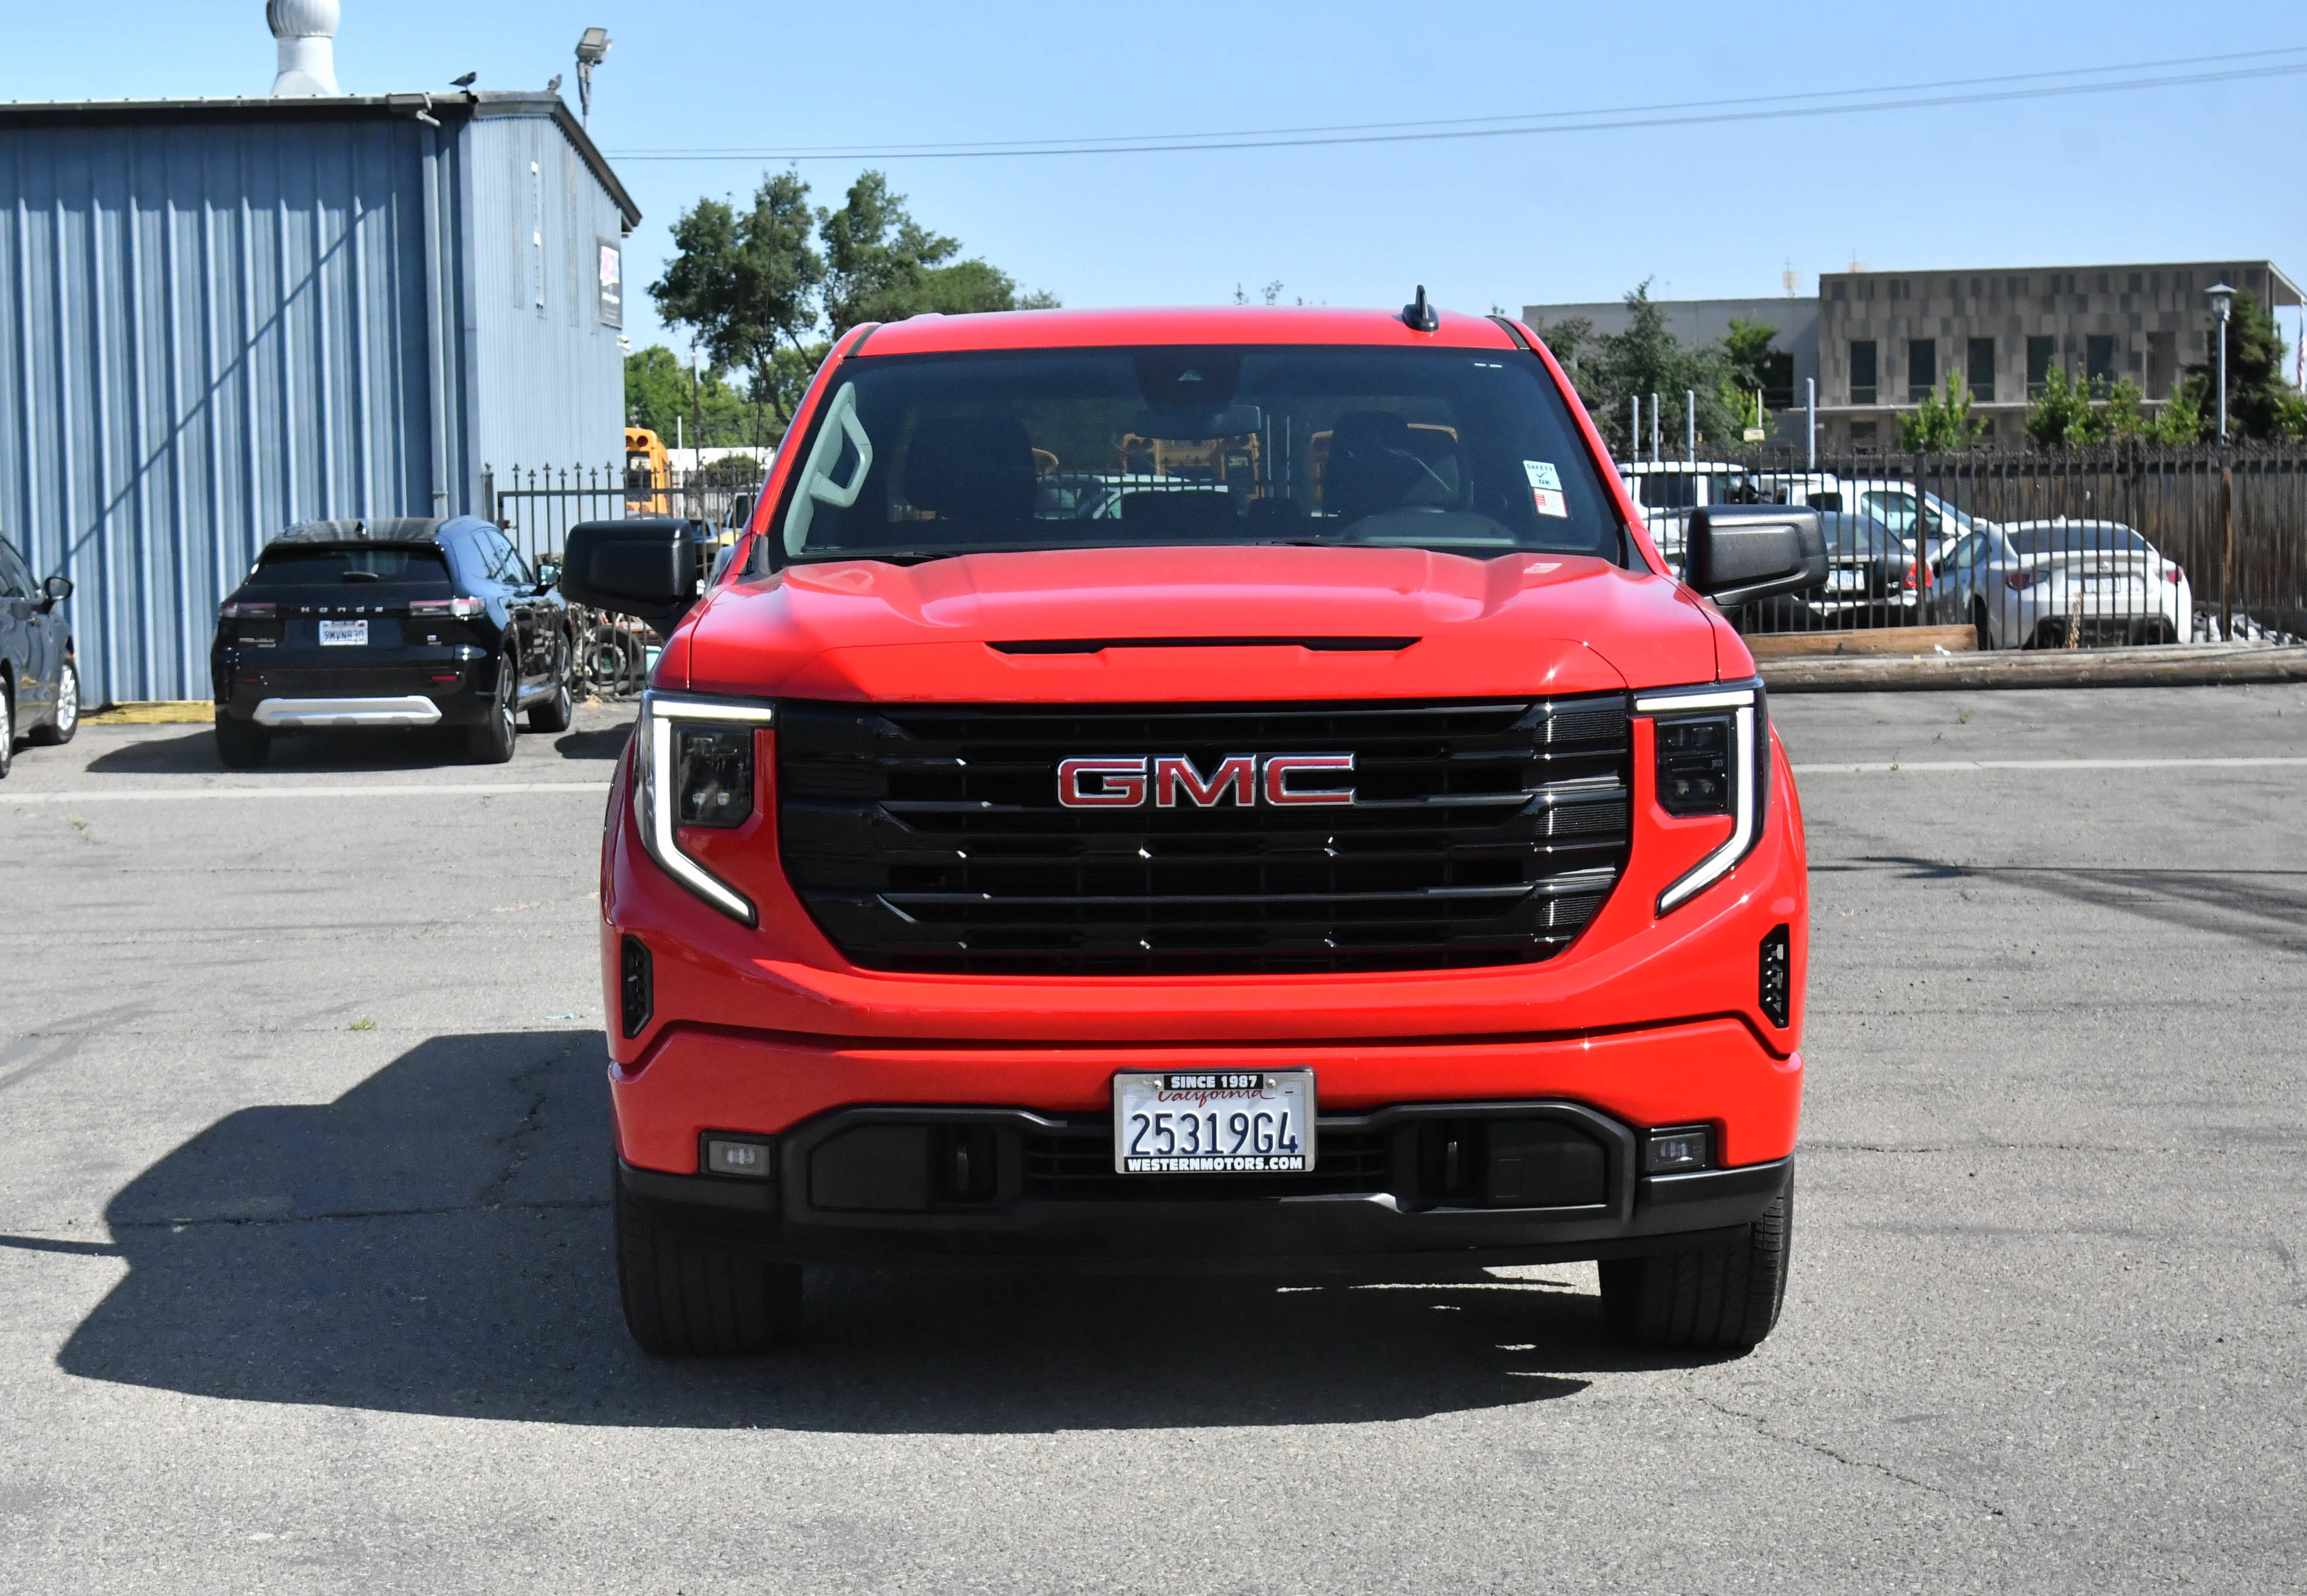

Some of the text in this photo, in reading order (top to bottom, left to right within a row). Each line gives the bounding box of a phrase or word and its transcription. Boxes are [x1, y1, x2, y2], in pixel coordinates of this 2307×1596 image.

[1058, 752, 1355, 807] GMC
[1171, 1075, 1257, 1088] SINCE 1987
[1131, 1112, 1298, 1155] 25319G4
[1128, 1157, 1303, 1171] WESTERNMOTORS.COM
